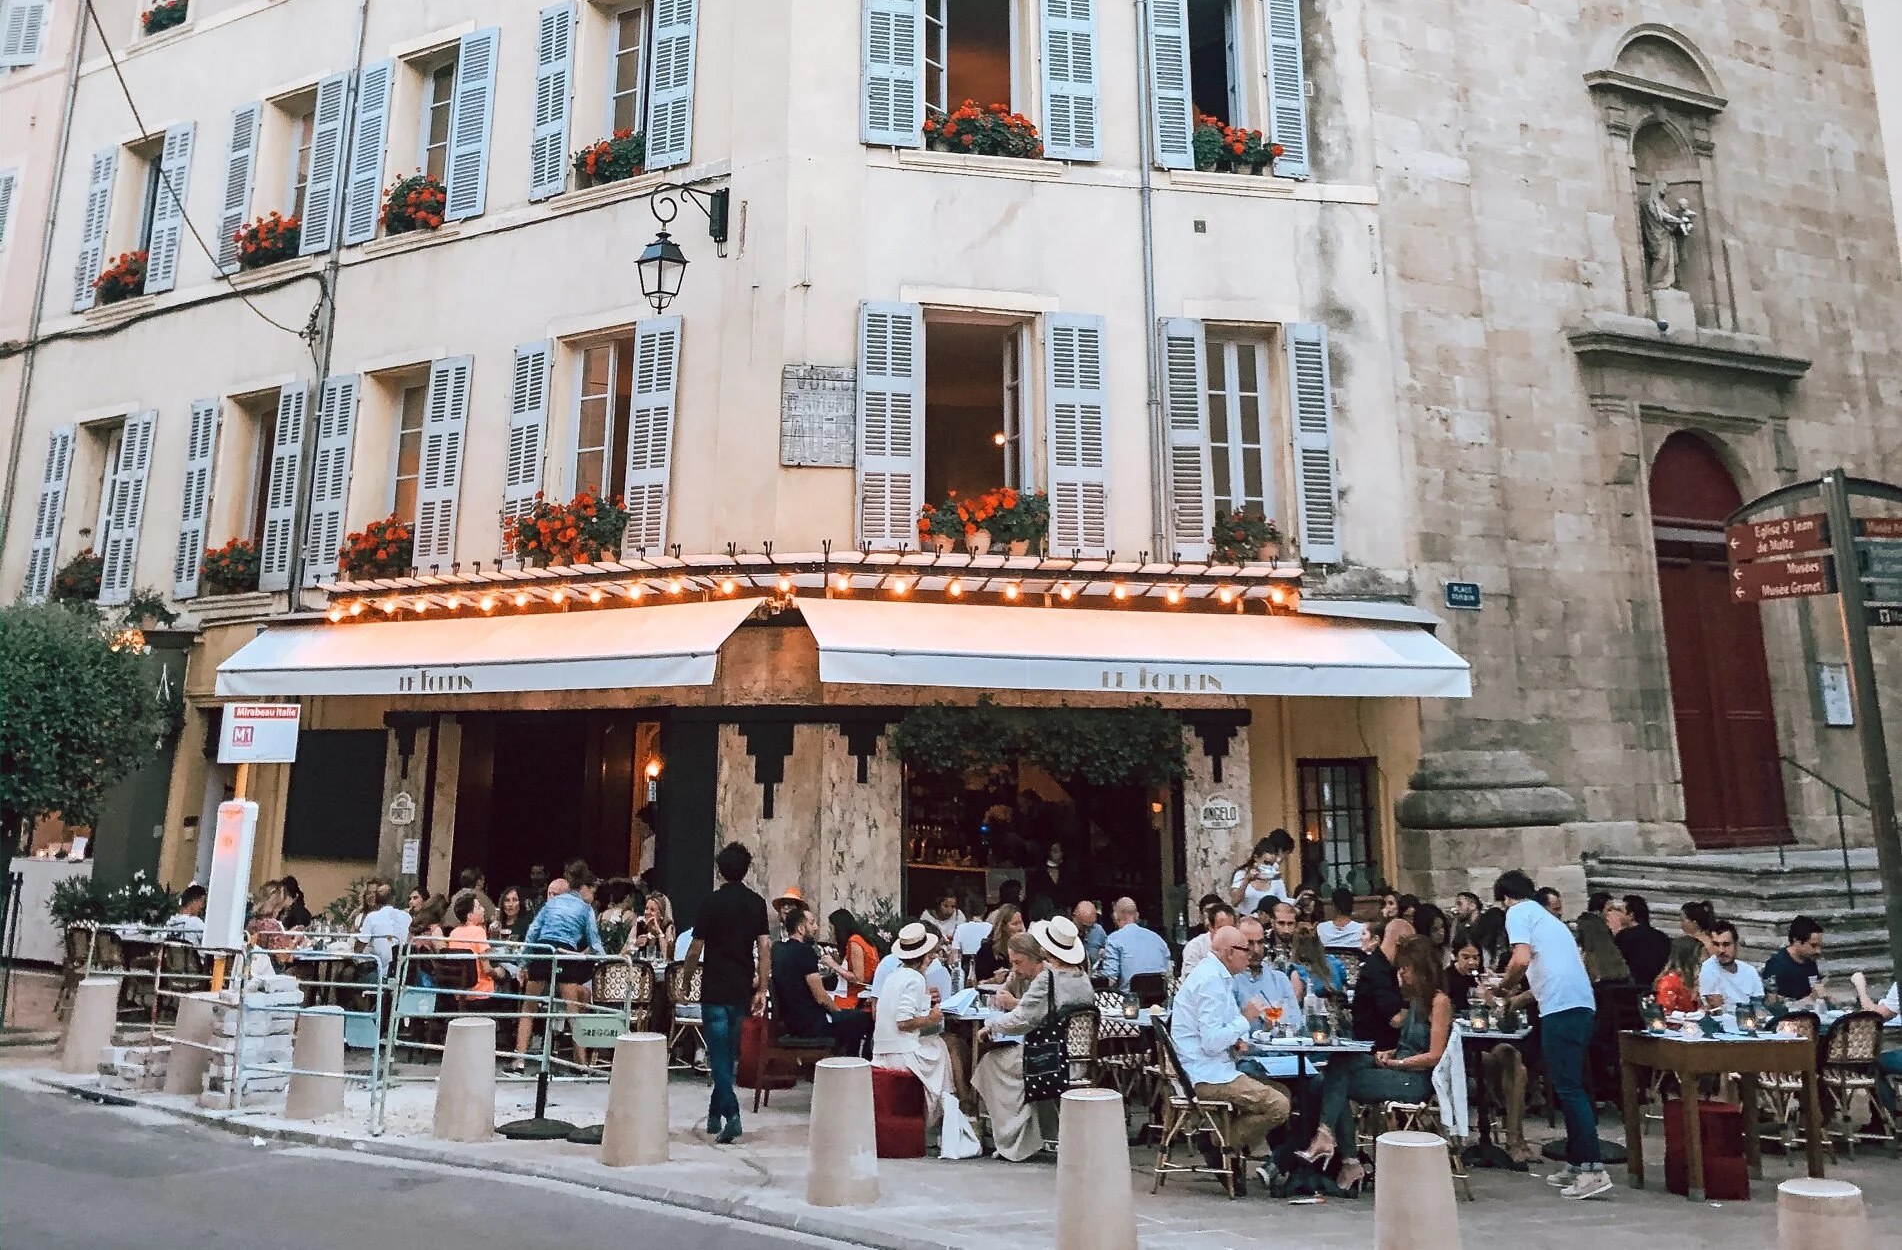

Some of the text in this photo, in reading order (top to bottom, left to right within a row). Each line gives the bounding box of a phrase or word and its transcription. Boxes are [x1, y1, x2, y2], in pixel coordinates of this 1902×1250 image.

[1793, 519, 1814, 533] Jean
[1757, 537, 1795, 553] de Malte
[1790, 581, 1822, 595] Granet
[236, 707, 297, 717] Mirabeau Italie
[234, 727, 252, 743] M1
[1203, 806, 1237, 821] ANGELO
